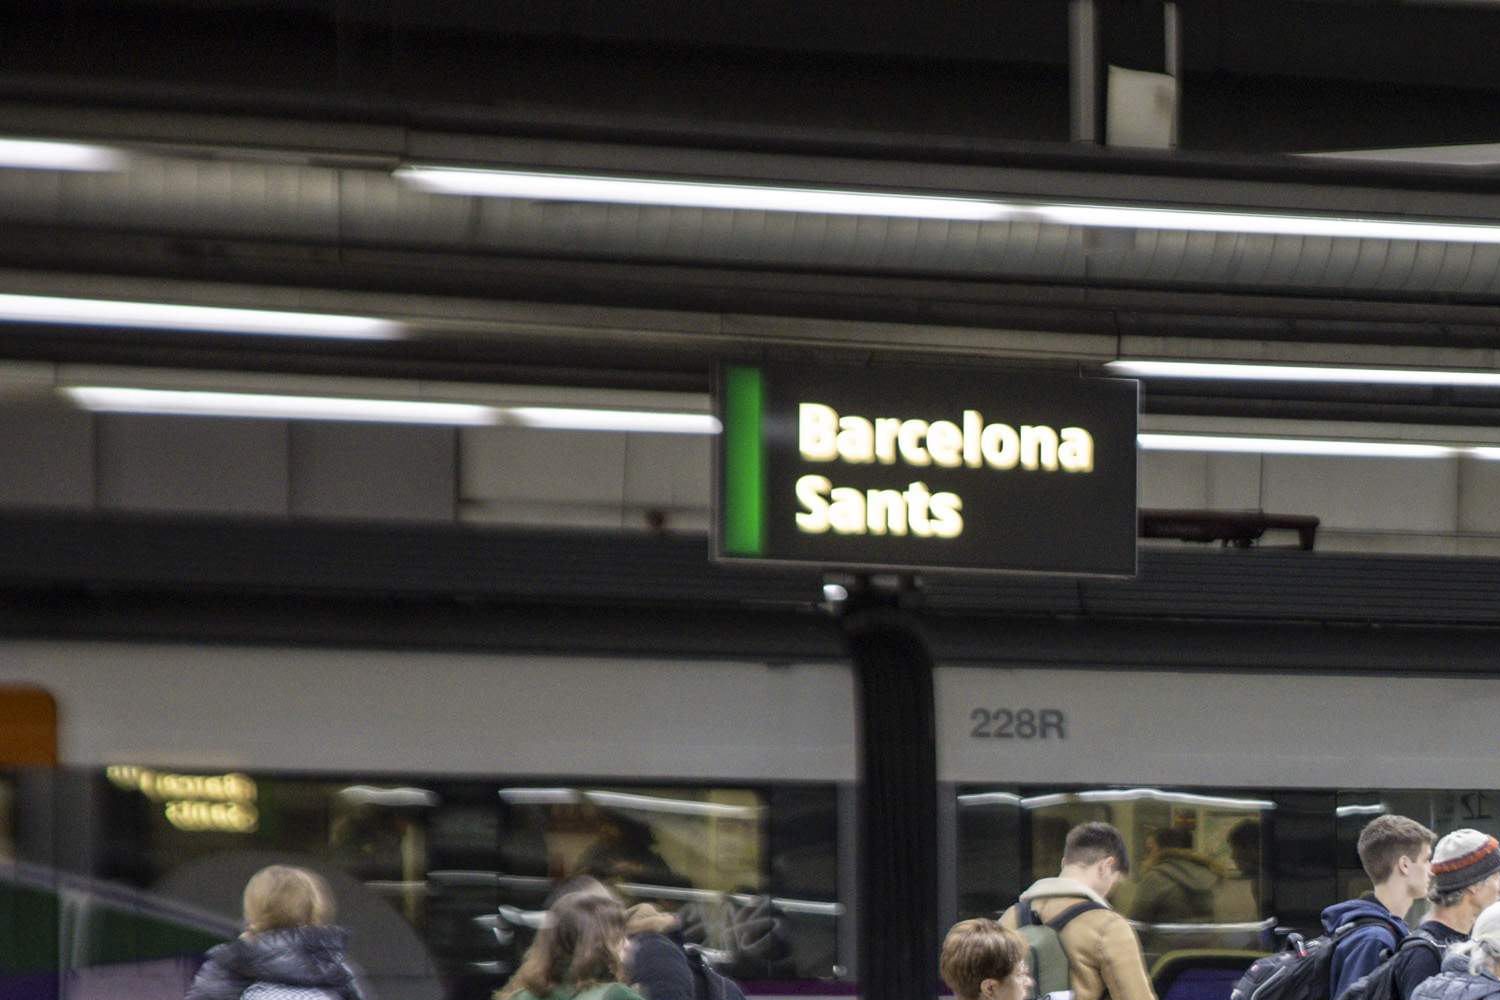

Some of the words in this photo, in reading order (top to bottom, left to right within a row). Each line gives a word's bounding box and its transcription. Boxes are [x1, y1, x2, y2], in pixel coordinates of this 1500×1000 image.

[799, 403, 1095, 473] Barcelona
[795, 475, 964, 539] Sants
[970, 707, 1064, 739] 228R
